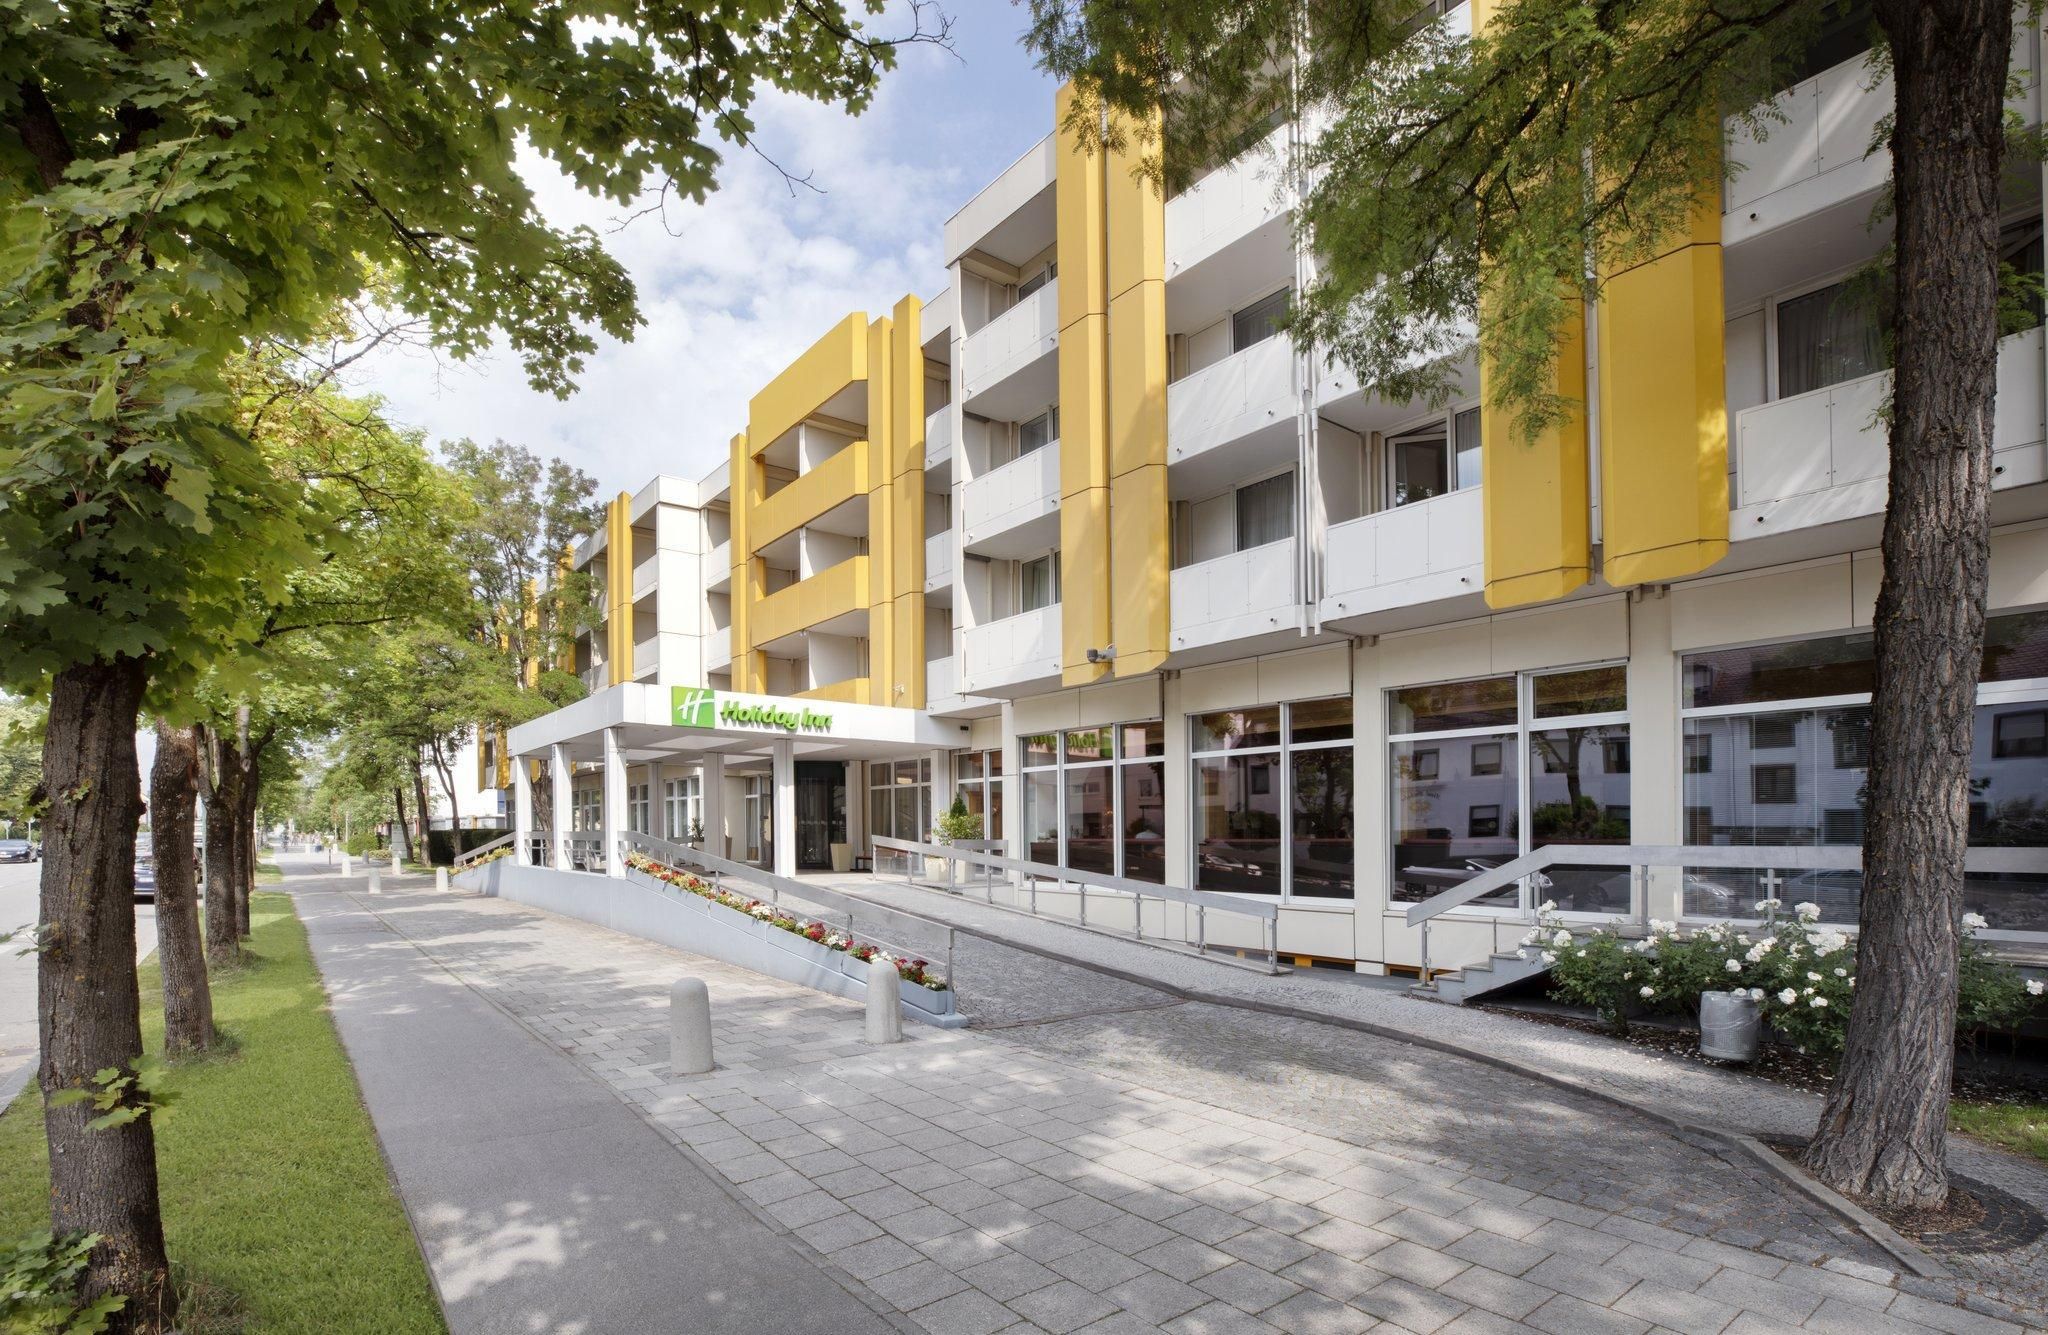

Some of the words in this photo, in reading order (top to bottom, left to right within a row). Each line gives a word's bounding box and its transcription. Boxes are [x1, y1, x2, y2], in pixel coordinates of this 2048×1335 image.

[677, 690, 715, 724] H
[720, 700, 799, 730] Holiday
[801, 707, 833, 728] Inn
